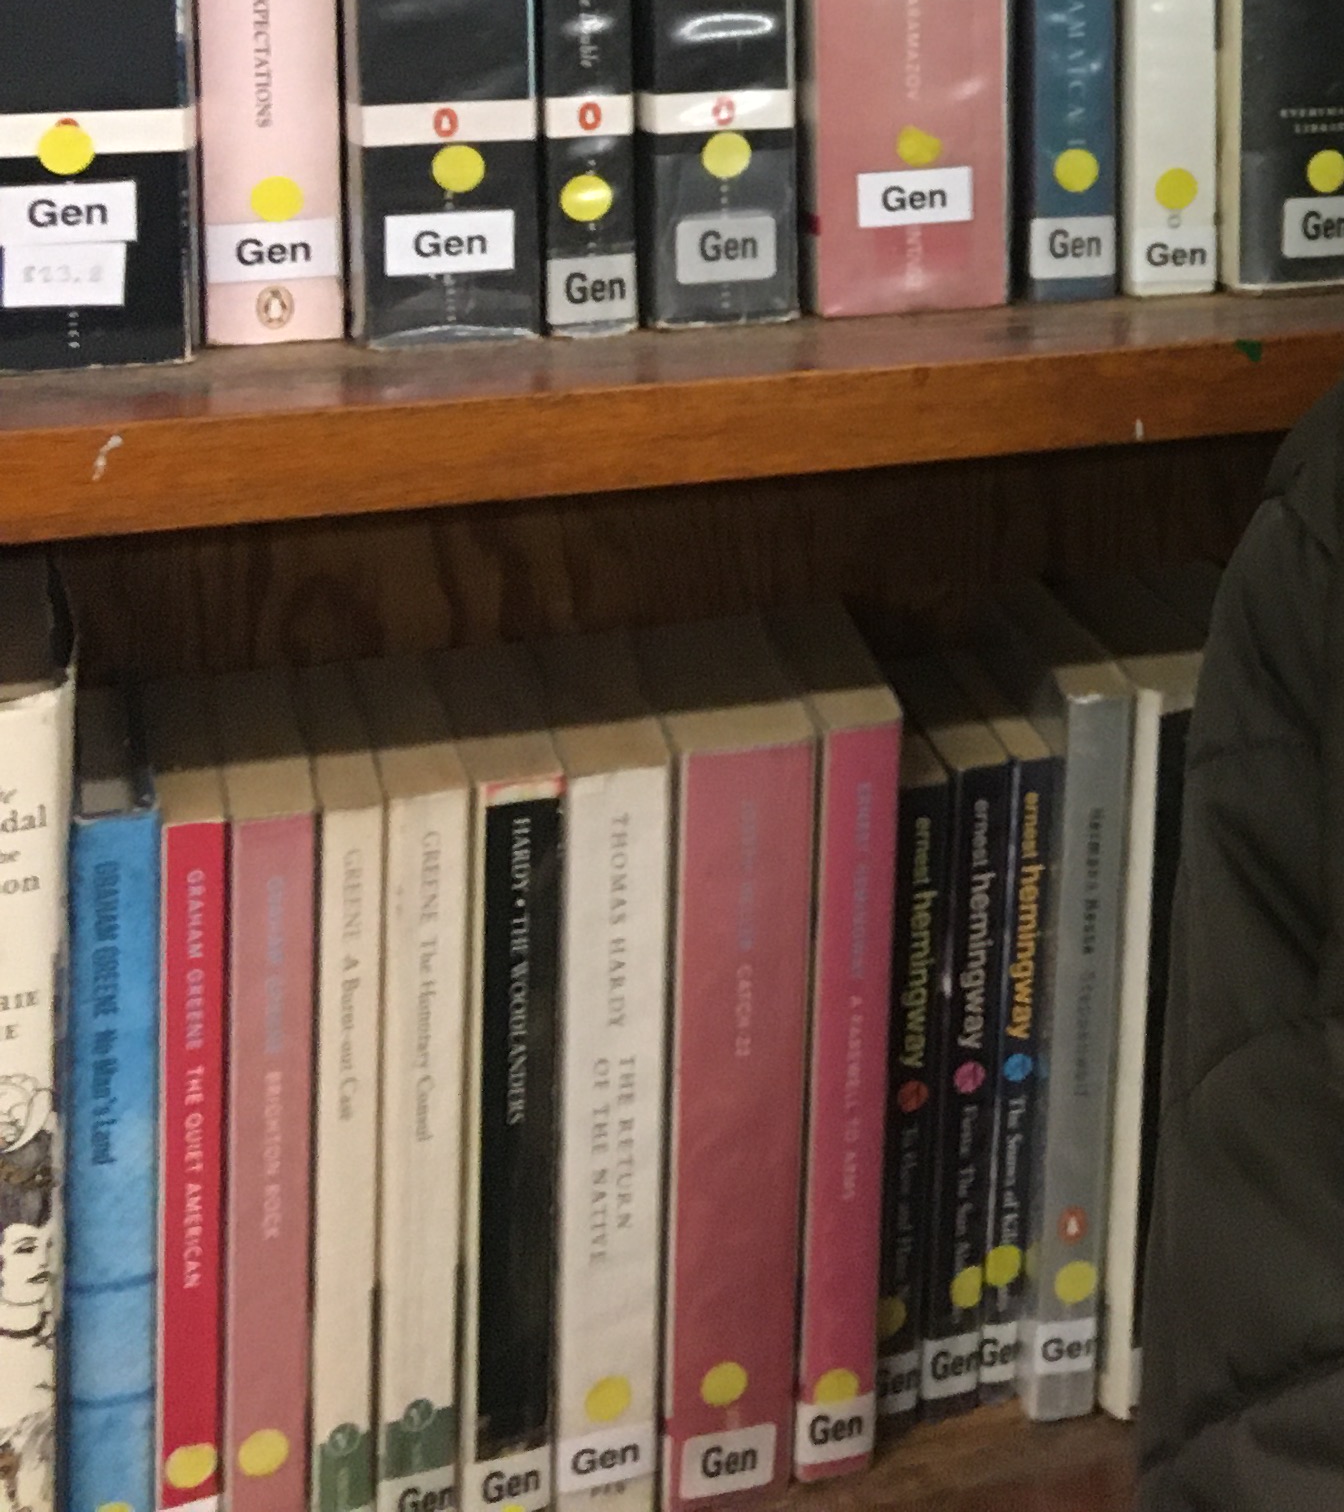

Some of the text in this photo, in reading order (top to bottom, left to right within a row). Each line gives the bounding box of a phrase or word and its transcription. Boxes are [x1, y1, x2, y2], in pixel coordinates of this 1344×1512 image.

[28, 198, 109, 230] Gen
[881, 185, 948, 214] Gen
[235, 236, 312, 266] Gen
[413, 229, 488, 258] Gen
[698, 229, 759, 261] Gen
[1048, 228, 1102, 259] Gen
[1146, 241, 1207, 268] Gen
[564, 270, 627, 305] Gen
[606, 811, 631, 1029] THOMAS HARDY
[957, 799, 996, 1050] ernest hemingway
[1006, 791, 1045, 1039] ernest hemingway
[899, 817, 938, 1069] ernest hemingway
[338, 848, 364, 1121] GREENE A Burnt-out Case
[414, 830, 442, 1142] GREENE The Honorary Consul
[506, 816, 531, 1126] HARDY THE WOODLANDERS
[182, 869, 205, 1289] GRAHAM GREENE THE QUIET AMERICAN
[92, 1118, 119, 1165] Land
[262, 1070, 282, 1241] BRIGHTON ROCK
[614, 1055, 637, 1231] THE RETURN
[587, 1058, 611, 1268] OF THE NATIVE
[930, 1348, 979, 1382] Gen
[1041, 1334, 1097, 1364] Gen
[809, 1413, 863, 1447] Gen
[571, 1439, 641, 1475] Gen
[701, 1446, 758, 1479] Gen
[481, 1466, 542, 1504] Gen
